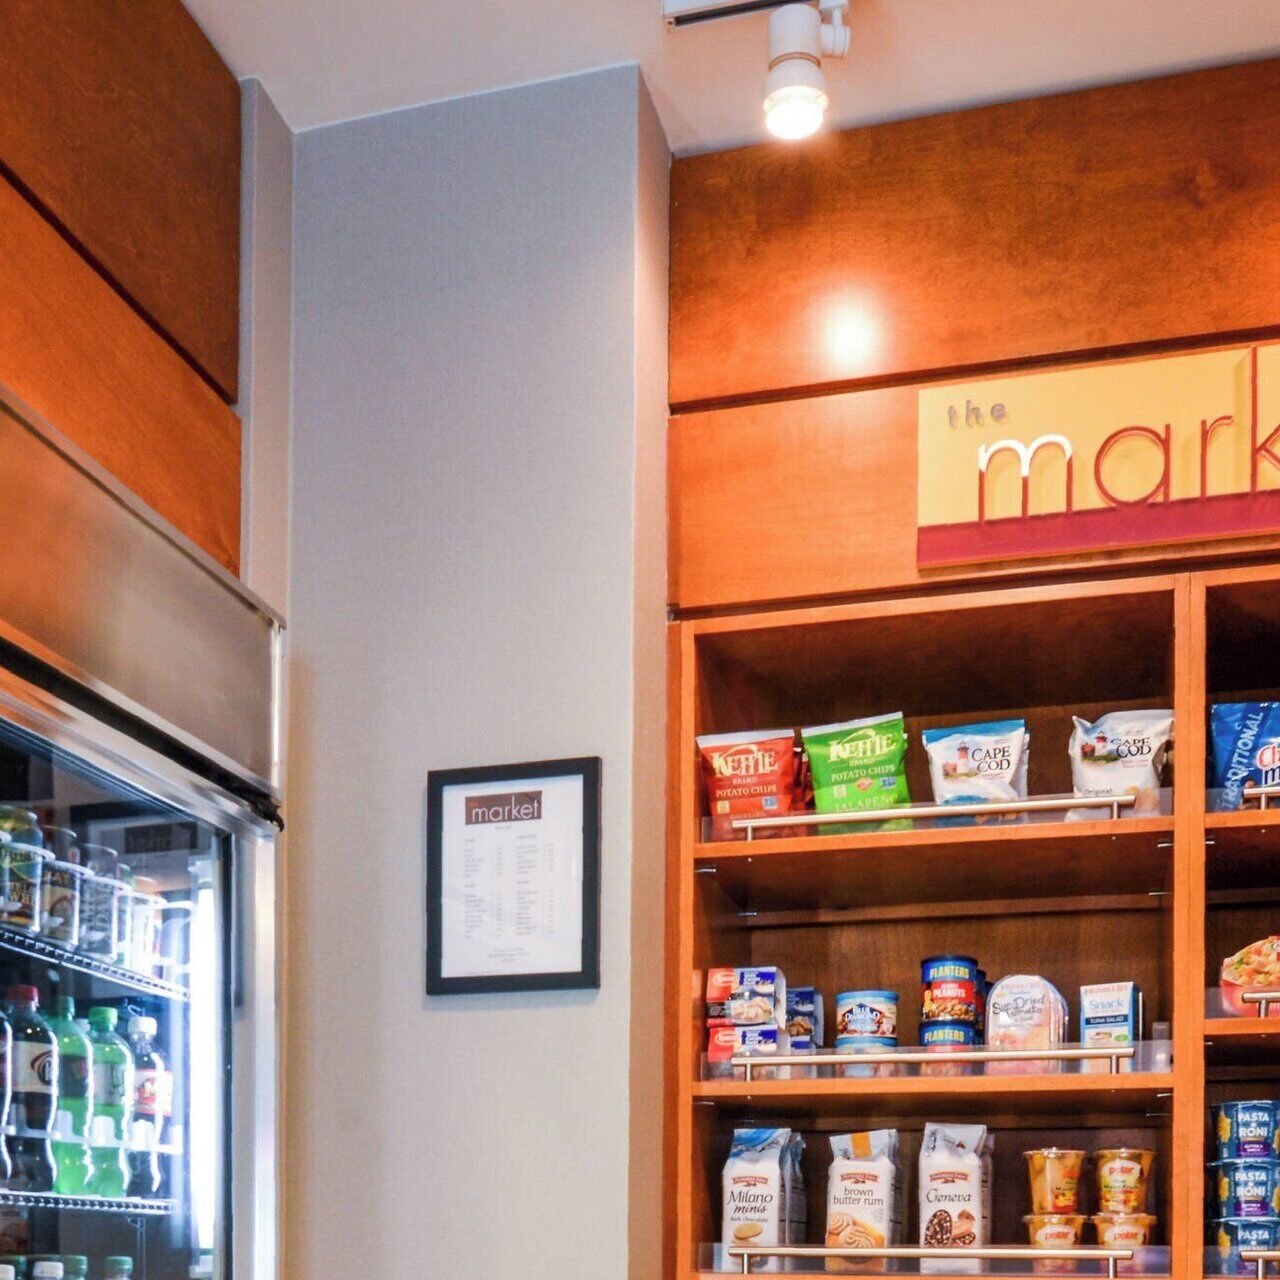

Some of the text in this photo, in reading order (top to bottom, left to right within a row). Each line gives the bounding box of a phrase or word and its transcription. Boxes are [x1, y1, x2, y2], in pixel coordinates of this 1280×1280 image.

[946, 399, 1009, 428] the
[828, 728, 896, 762] KETTLE
[1109, 736, 1151, 747] CAPE
[971, 745, 1012, 763] CAPE
[1115, 743, 1152, 760] COD
[711, 744, 779, 777] KETTLE
[977, 757, 1012, 773] COD
[1222, 712, 1265, 808] TRADITIONAL
[831, 764, 896, 783] POTATO CHIPS
[716, 784, 778, 797] POTATO CHIPS
[472, 795, 539, 823] market
[929, 964, 971, 979] PLANTERS
[924, 1029, 966, 1044] PLANTERS
[1237, 1111, 1270, 1123] PASTA
[1238, 1127, 1268, 1138] RONI
[1235, 1171, 1267, 1182] PASTA
[725, 1188, 773, 1204] Milano
[844, 1186, 874, 1197] brown
[925, 1188, 972, 1204] Geneva
[1236, 1186, 1267, 1197] RONI
[832, 1194, 884, 1206] butter rum
[733, 1203, 767, 1215] minis
[1237, 1229, 1270, 1240] PASTA
